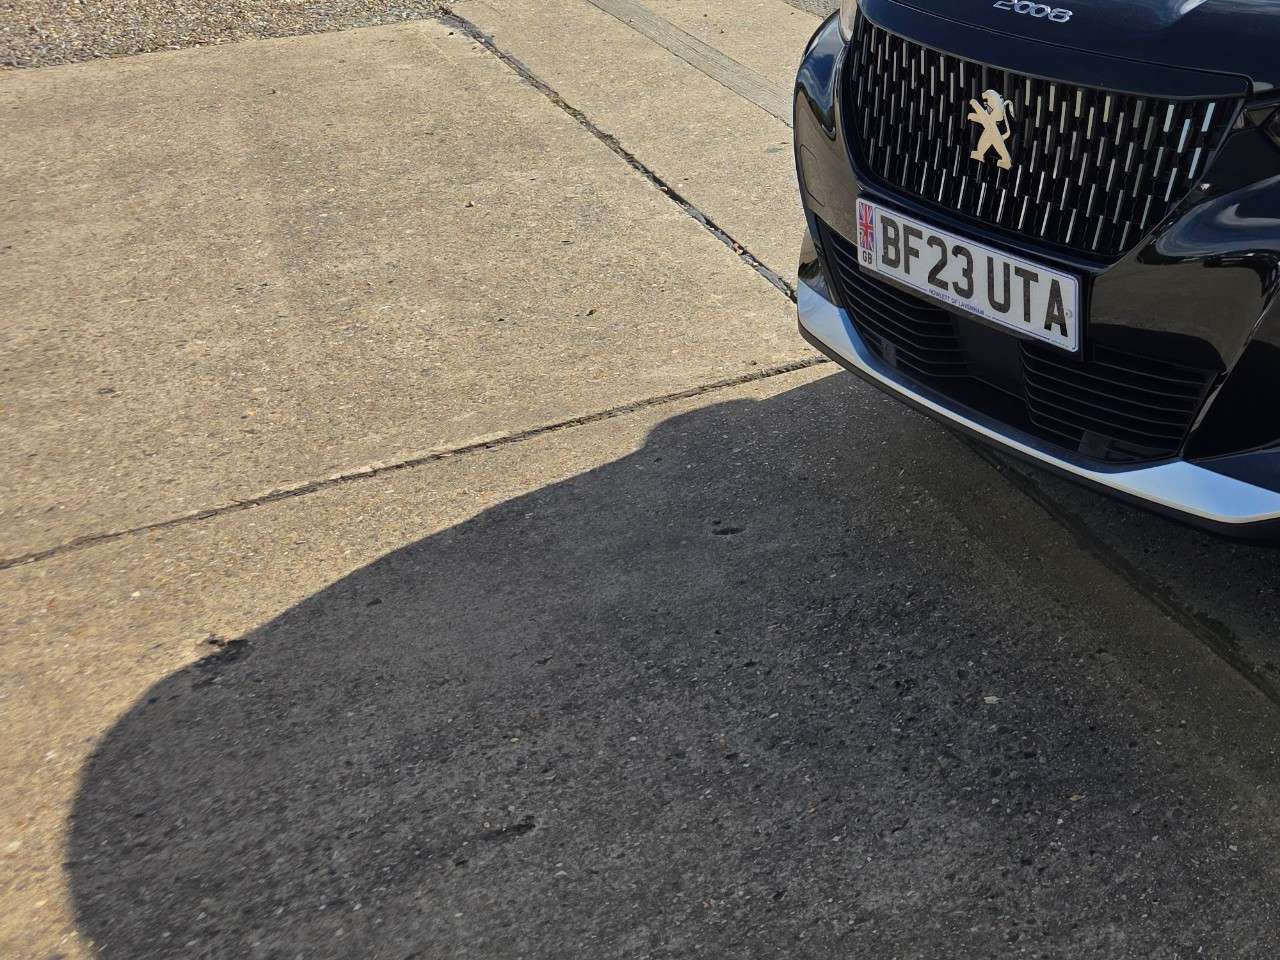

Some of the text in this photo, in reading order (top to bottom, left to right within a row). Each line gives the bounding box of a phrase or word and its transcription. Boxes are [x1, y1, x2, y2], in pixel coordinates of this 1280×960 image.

[862, 250, 873, 265] GB
[880, 214, 1069, 338] BF23 UTA
